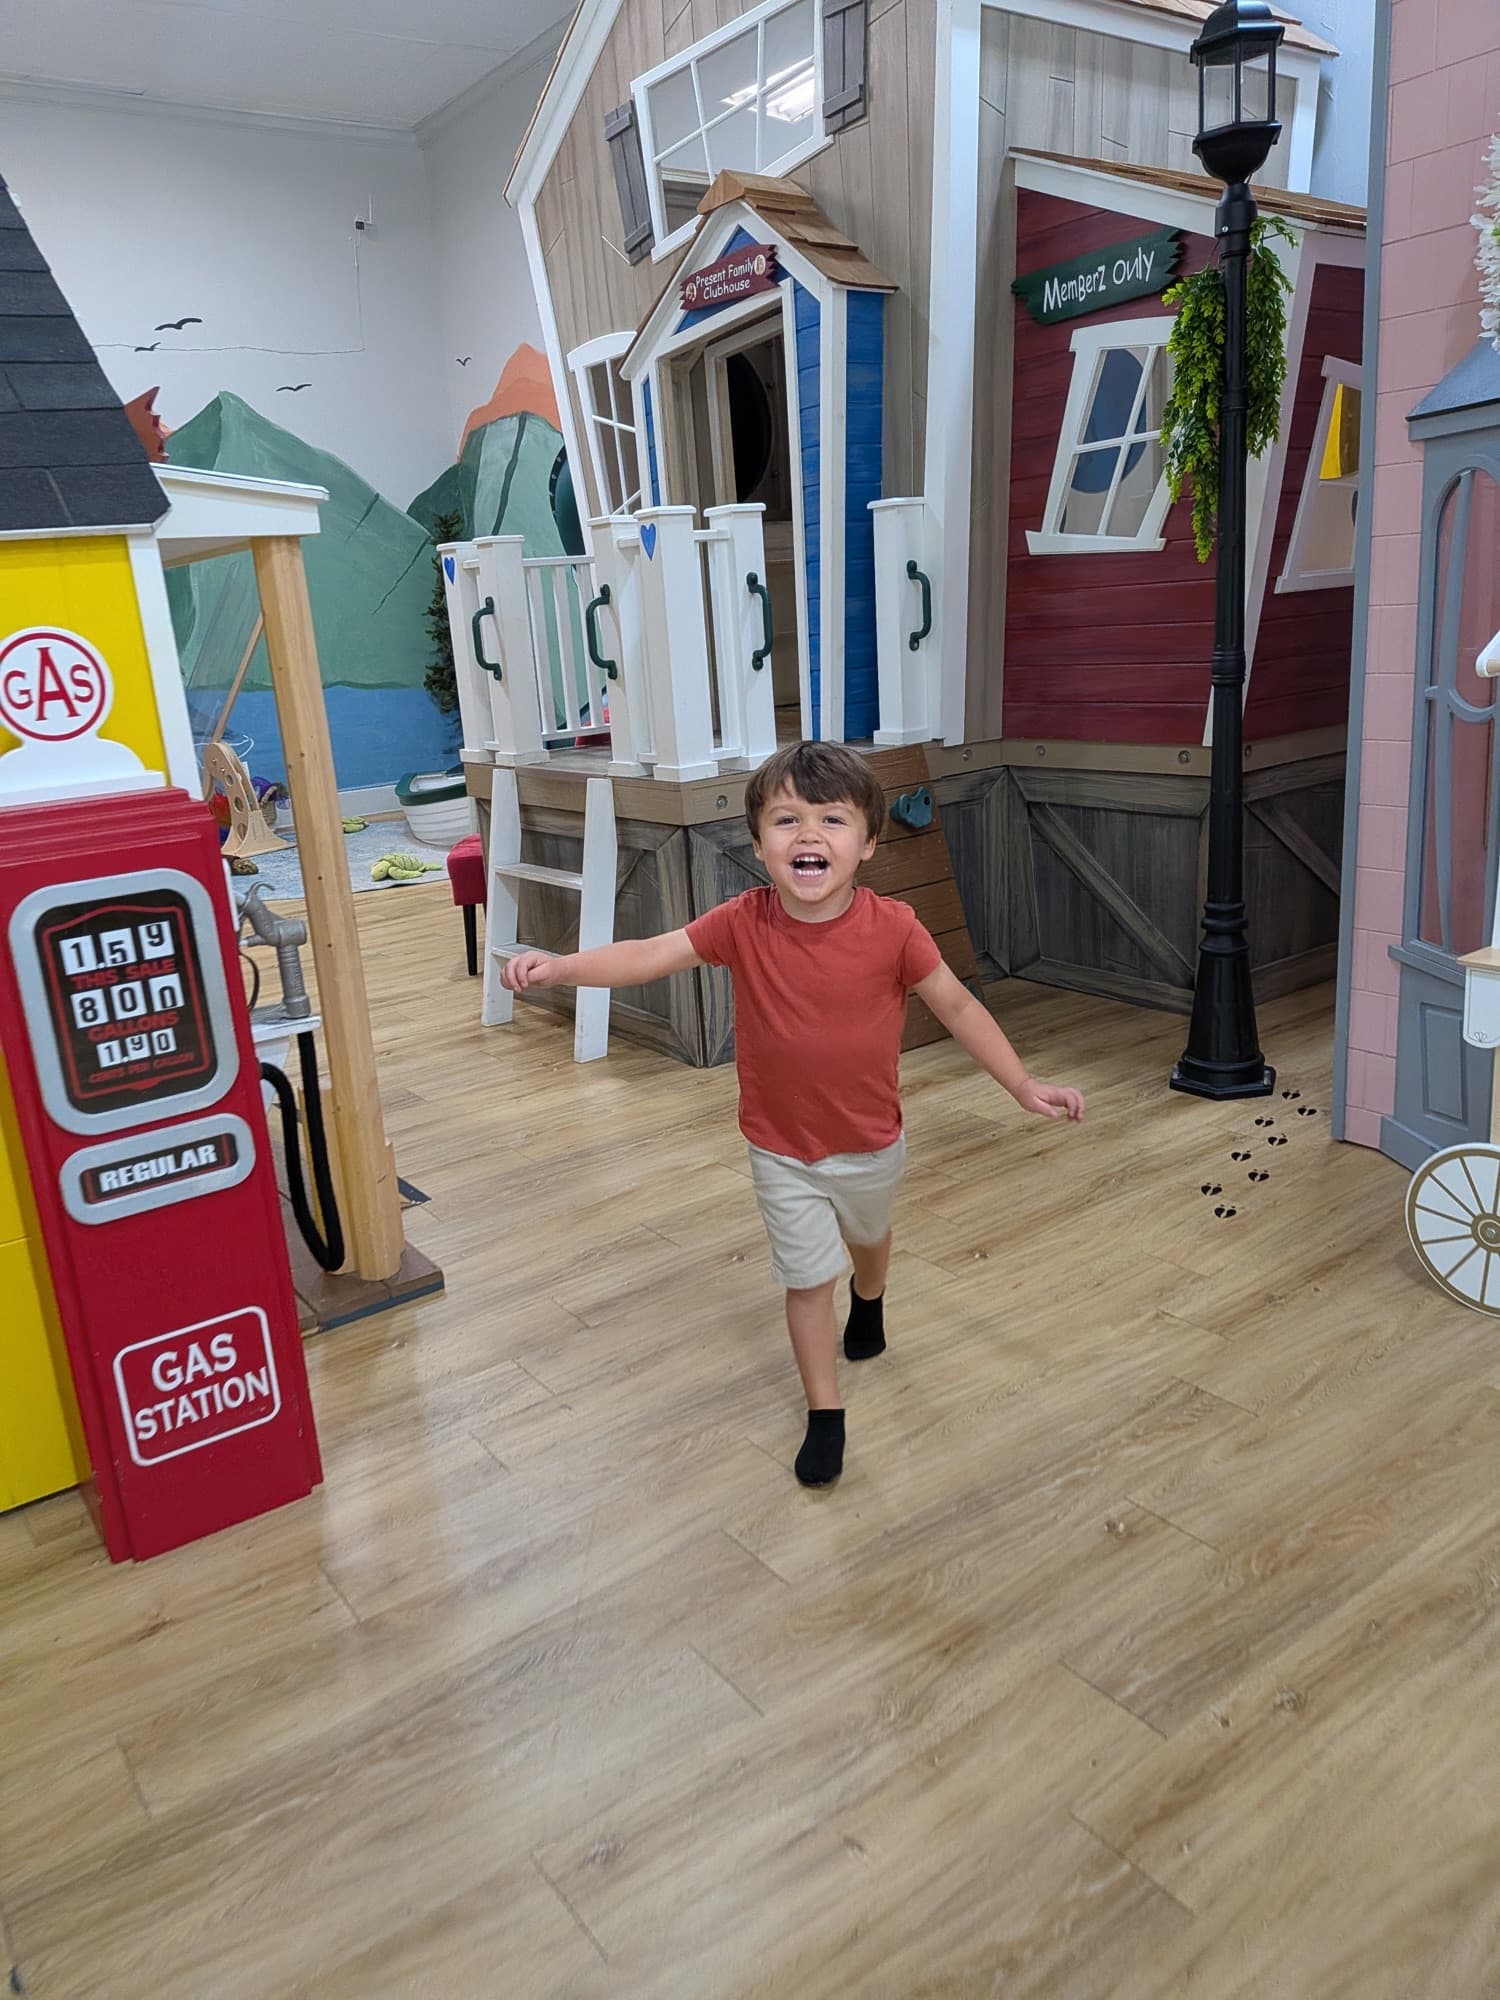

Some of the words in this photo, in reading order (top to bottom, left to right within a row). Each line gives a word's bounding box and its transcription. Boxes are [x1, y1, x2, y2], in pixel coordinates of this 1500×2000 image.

[695, 269, 726, 288] Present
[728, 256, 756, 279] Family
[703, 279, 751, 300] Clubhouse
[4, 646, 95, 721] GAS
[71, 971, 119, 989] THIS
[126, 958, 177, 980] SALE
[88, 1011, 179, 1041] GALLONS
[98, 1144, 218, 1192] REGULAR
[151, 1333, 237, 1392] GAS
[134, 1366, 270, 1440] STATION
